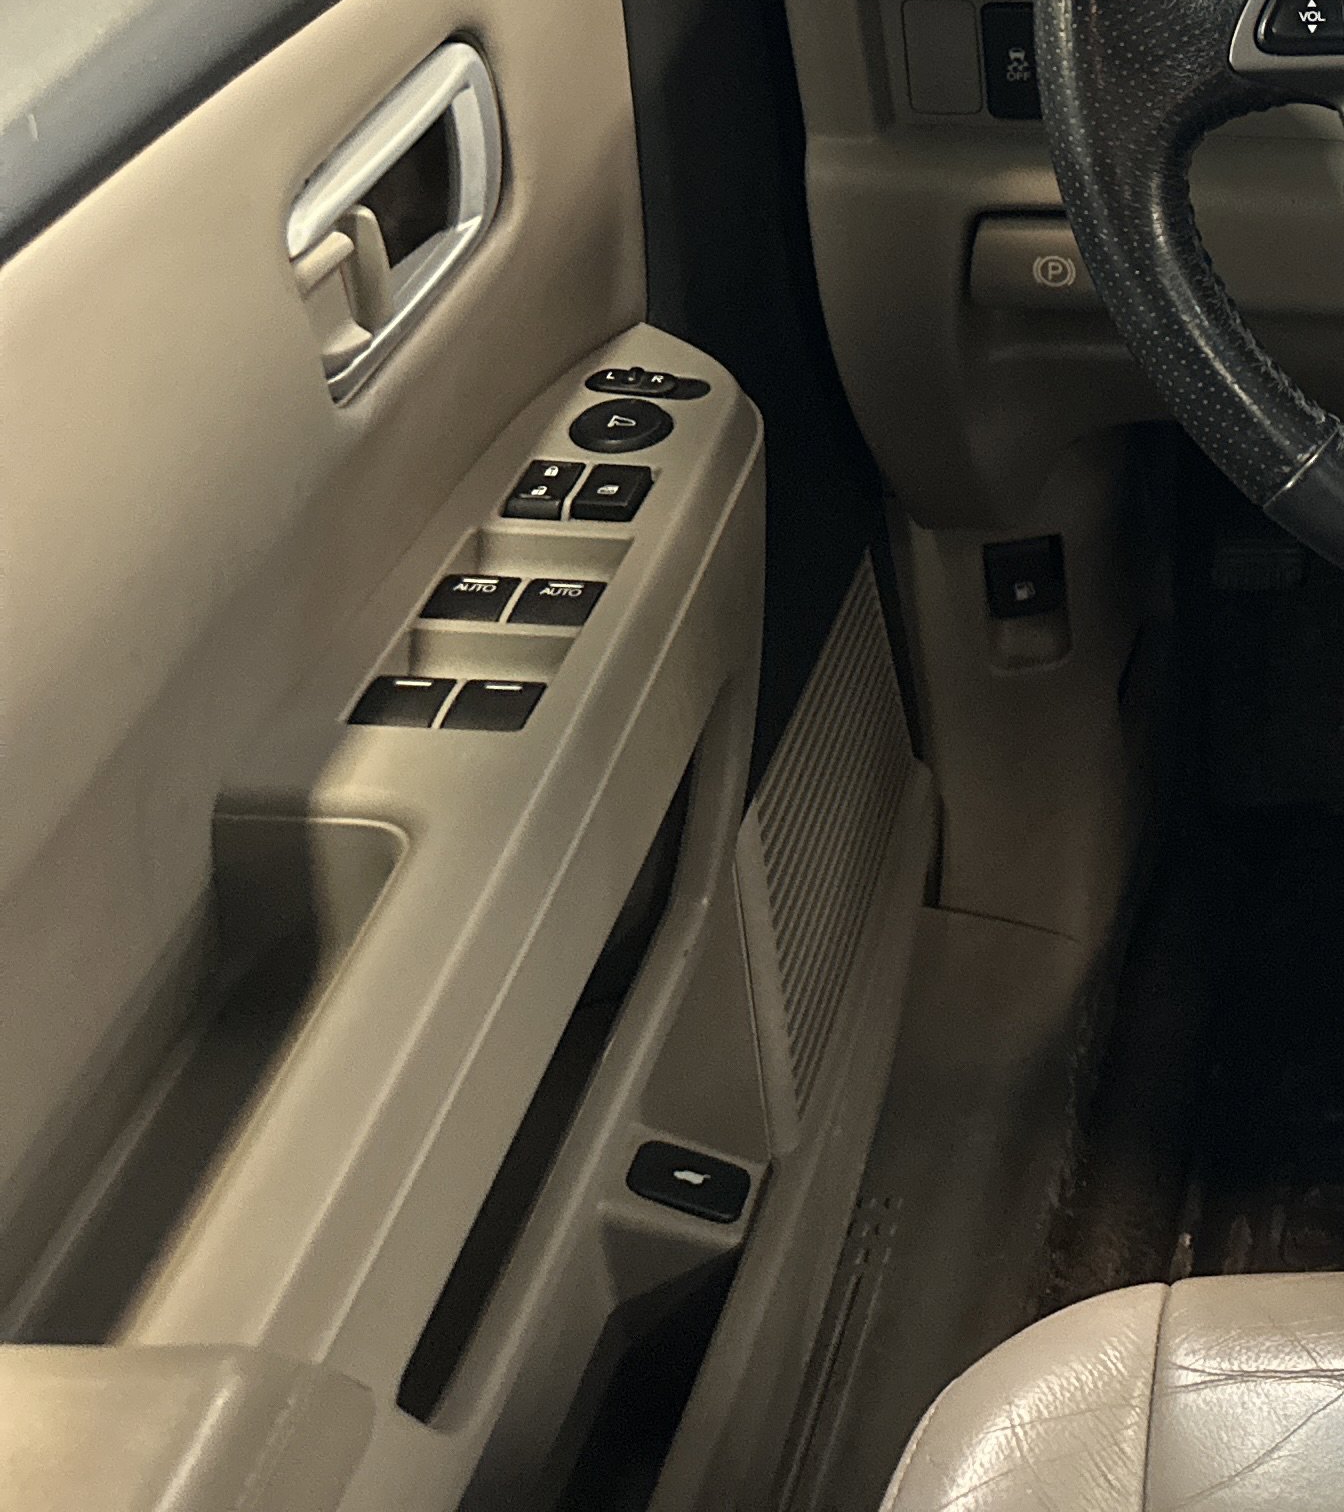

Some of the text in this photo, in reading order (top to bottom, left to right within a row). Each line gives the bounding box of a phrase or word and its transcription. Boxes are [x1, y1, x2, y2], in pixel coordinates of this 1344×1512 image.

[1299, 11, 1326, 22] VOL
[1006, 69, 1030, 82] OFF
[650, 374, 665, 384] R
[453, 582, 582, 597] AUTO AUTO
